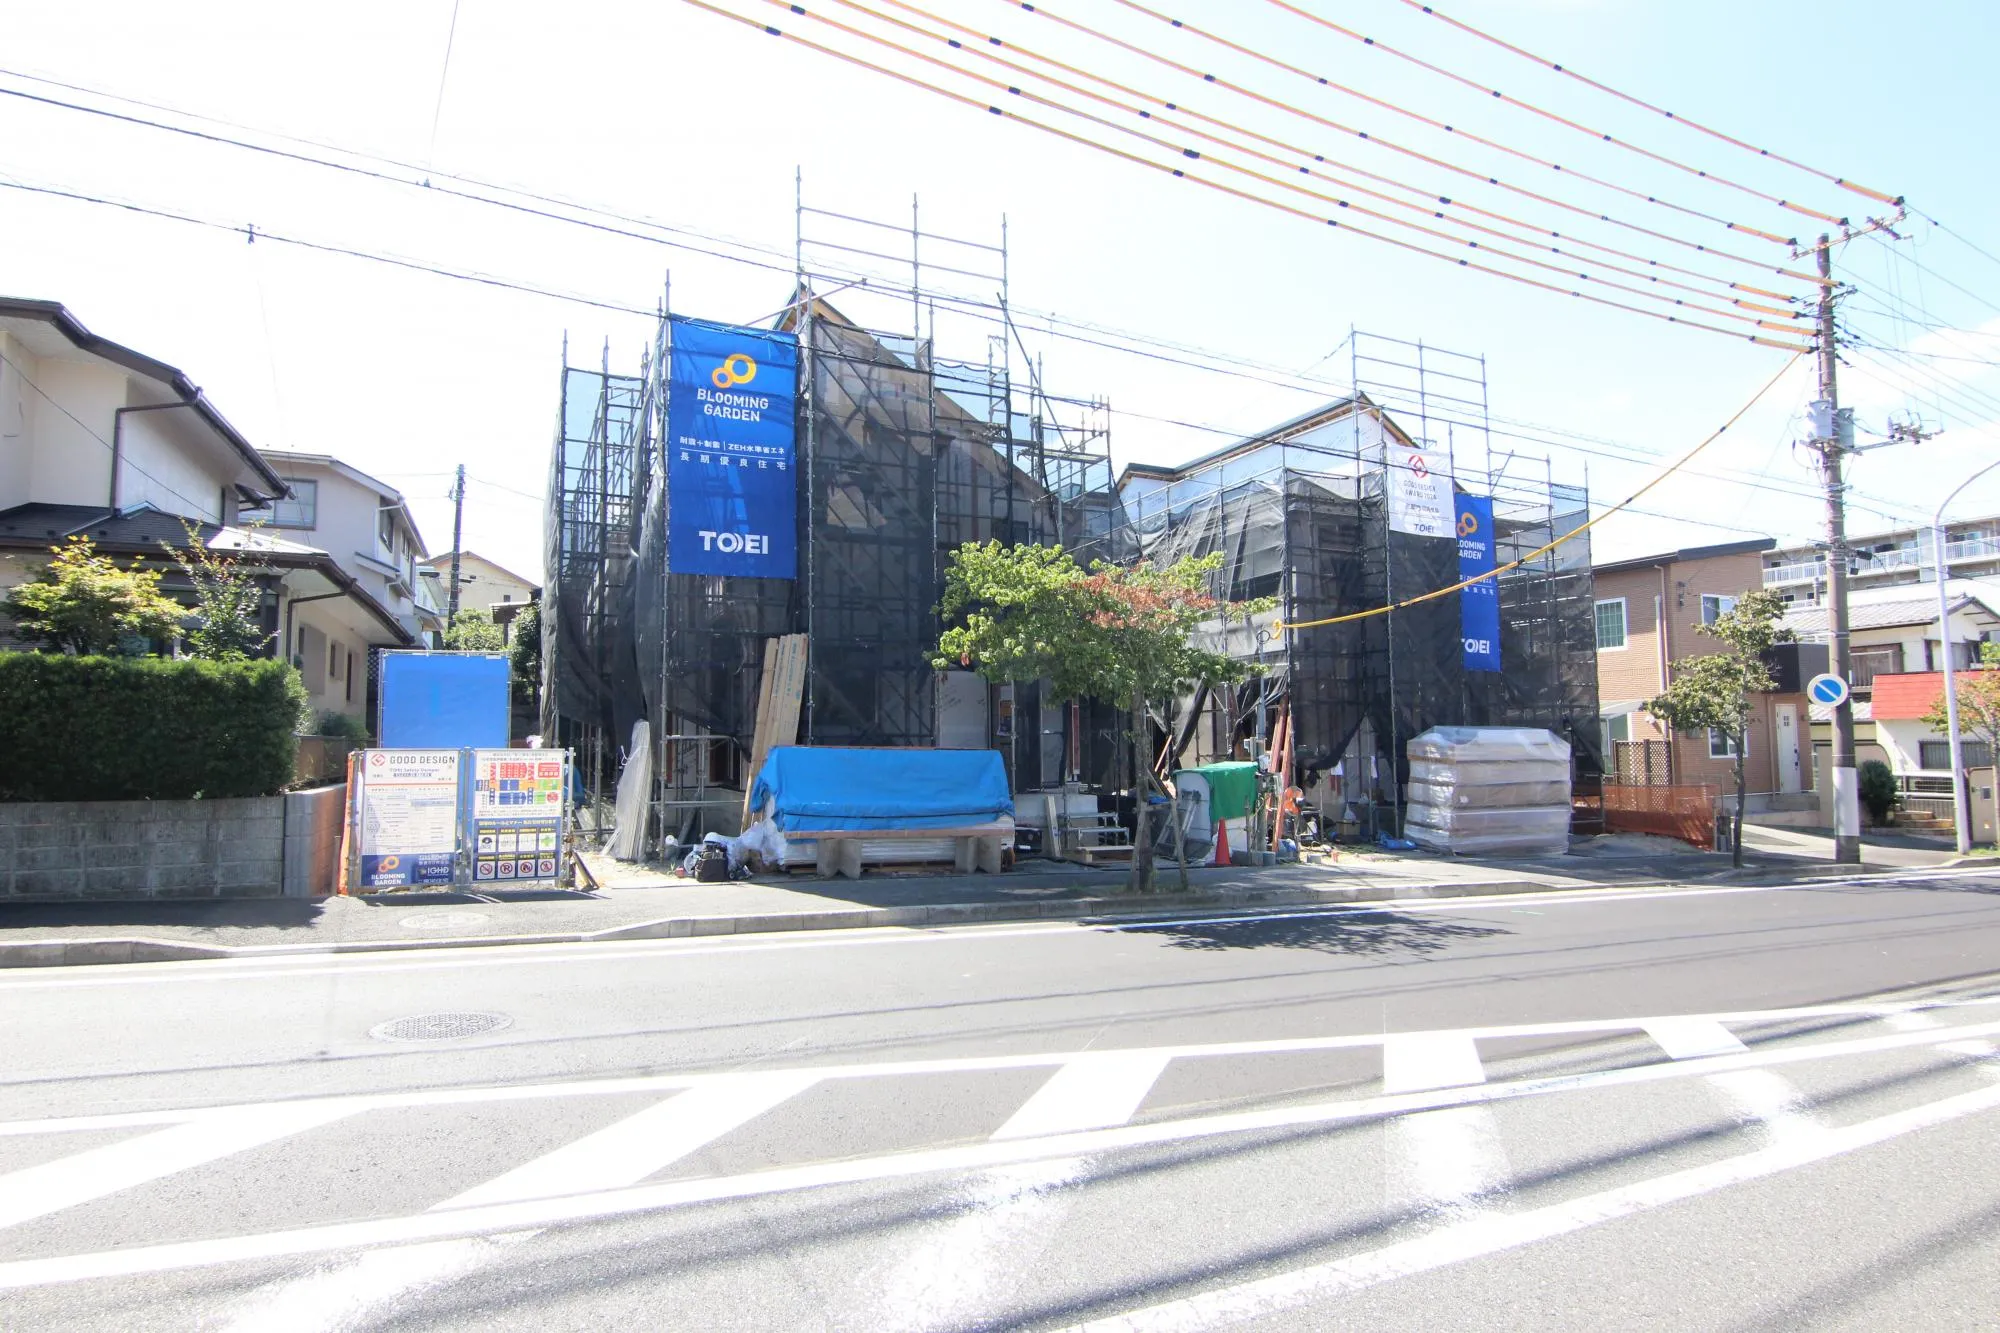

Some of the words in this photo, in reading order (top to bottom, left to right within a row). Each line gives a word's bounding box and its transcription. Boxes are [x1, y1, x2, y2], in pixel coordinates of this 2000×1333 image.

[697, 388, 769, 410] BLOOMING
[703, 403, 760, 422] GARDEN
[698, 530, 769, 555] TOEI
[1457, 540, 1486, 551] OOMING
[1458, 549, 1482, 560] ARDEN
[389, 755, 416, 764] GOOD
[419, 755, 455, 764] DESIGN
